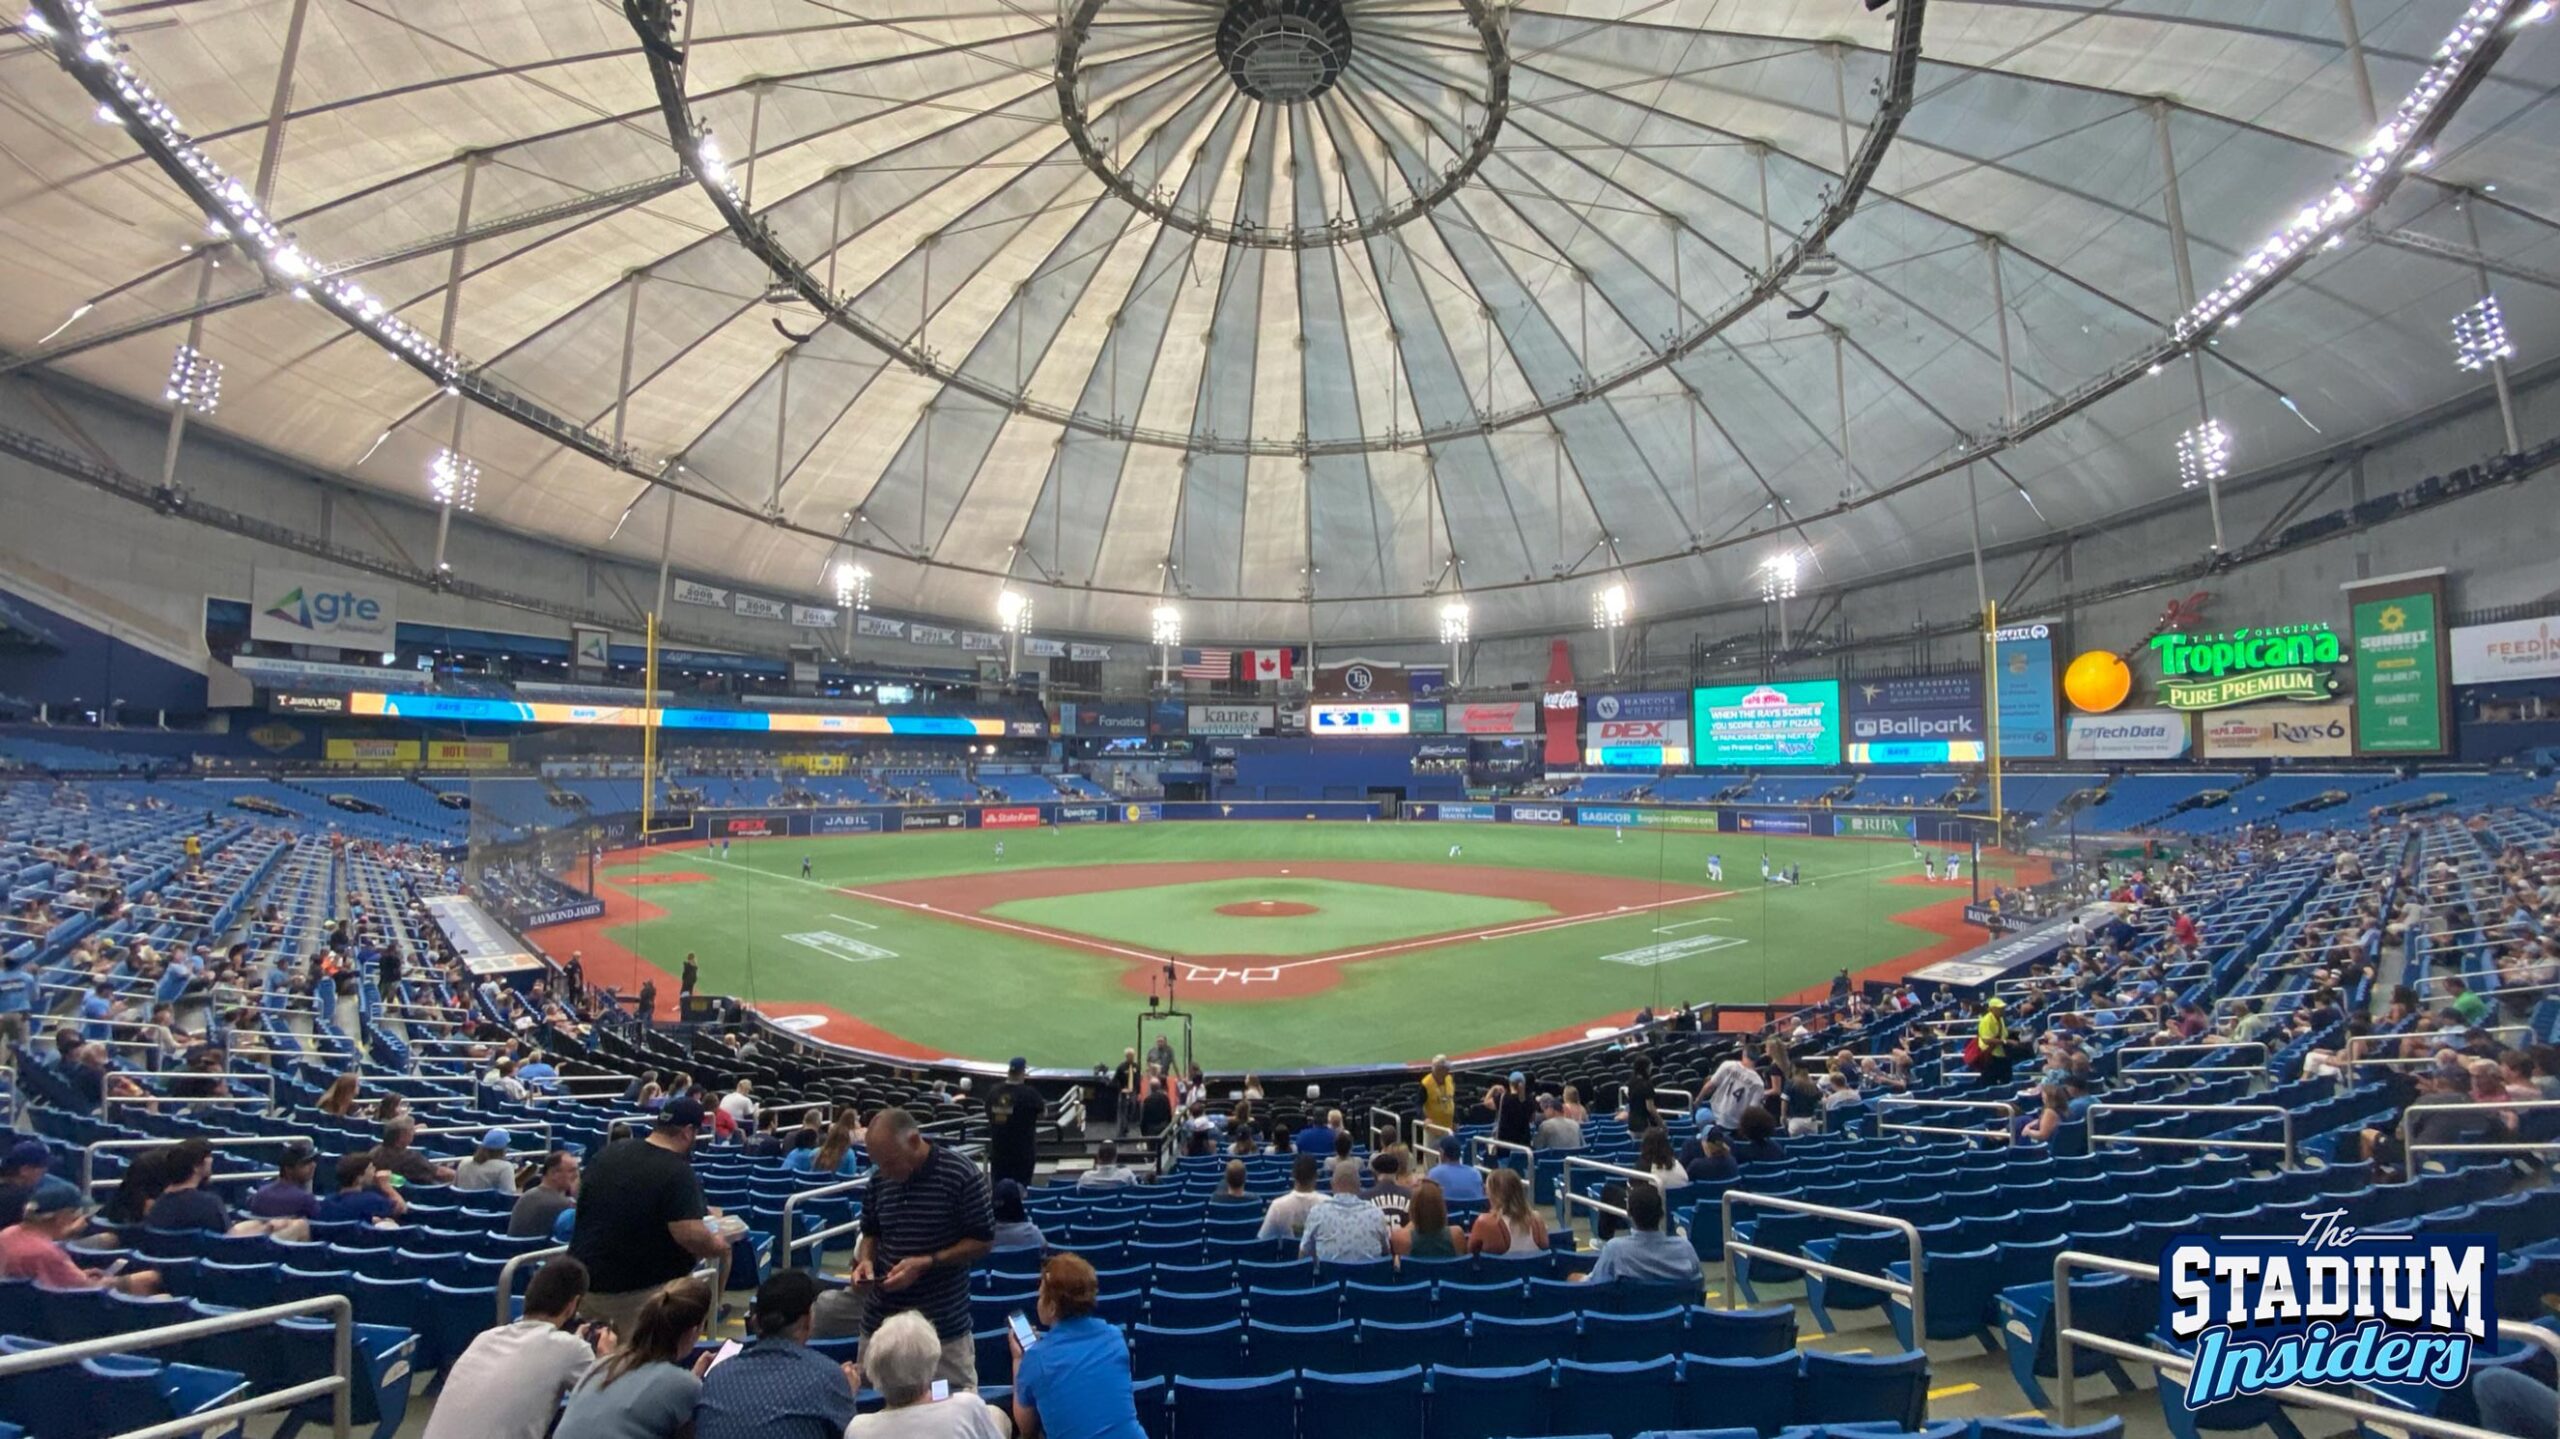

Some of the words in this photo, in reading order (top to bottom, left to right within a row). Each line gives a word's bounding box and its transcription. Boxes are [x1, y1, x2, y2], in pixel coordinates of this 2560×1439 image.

[314, 591, 380, 623] gte
[2192, 633, 2225, 644] THE
[2254, 621, 2330, 637] ORIGINAL
[2360, 630, 2429, 649] SUNBELT
[2151, 631, 2340, 677] Tropicana
[2502, 651, 2542, 664] Tampa
[1918, 678, 1970, 688] BASEBALL
[2170, 688, 2218, 706] PURE
[2221, 673, 2314, 700] PREMIUM
[1711, 710, 1738, 720] WHEN
[1740, 709, 1756, 719] THE
[1757, 708, 1781, 718] RAYS
[1782, 707, 1811, 717] SCORE
[1099, 715, 1146, 728] Fanatics
[1711, 721, 1727, 730] YOU
[1728, 720, 1754, 730] SCORE
[1879, 715, 1974, 738] Ballpark
[1601, 720, 1665, 739] DEX
[1063, 807, 1098, 818] Spectrum
[1513, 808, 1562, 821] GEICO
[1581, 811, 1632, 823] SAGICOR
[825, 816, 869, 826] JABIL
[1863, 817, 1900, 832] RIPA
[529, 907, 574, 927] RAYMOND
[573, 903, 601, 918] JAMES
